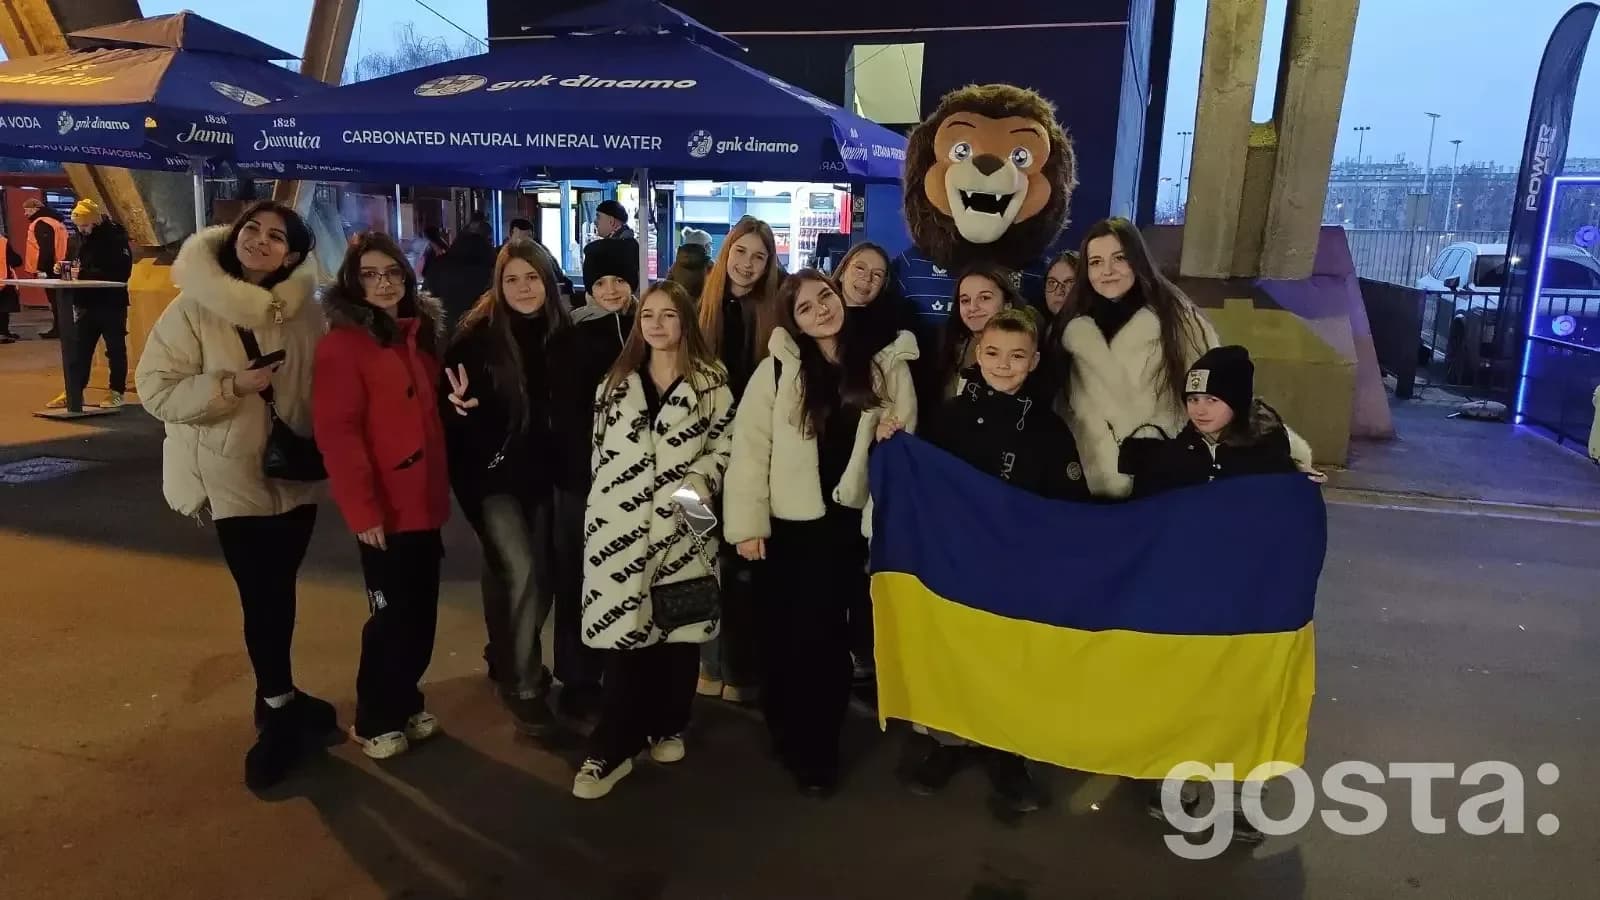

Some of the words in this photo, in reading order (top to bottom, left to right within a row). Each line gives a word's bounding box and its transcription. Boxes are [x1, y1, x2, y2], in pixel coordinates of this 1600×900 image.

[486, 74, 558, 92] gnk
[558, 73, 697, 91] dinamo
[7, 116, 42, 129] VODA
[73, 116, 91, 131] gnk
[91, 116, 130, 130] dinamo
[204, 114, 228, 125] 1828
[272, 117, 297, 128] 1828
[253, 129, 321, 151] Jamnica
[342, 130, 446, 146] CARBONATED
[449, 132, 522, 147] NATURAL
[526, 133, 599, 149] MINERAL
[602, 134, 662, 151] WATER
[716, 136, 744, 154] gnk
[745, 136, 799, 154] dinamo
[1525, 123, 1551, 212] POWER
